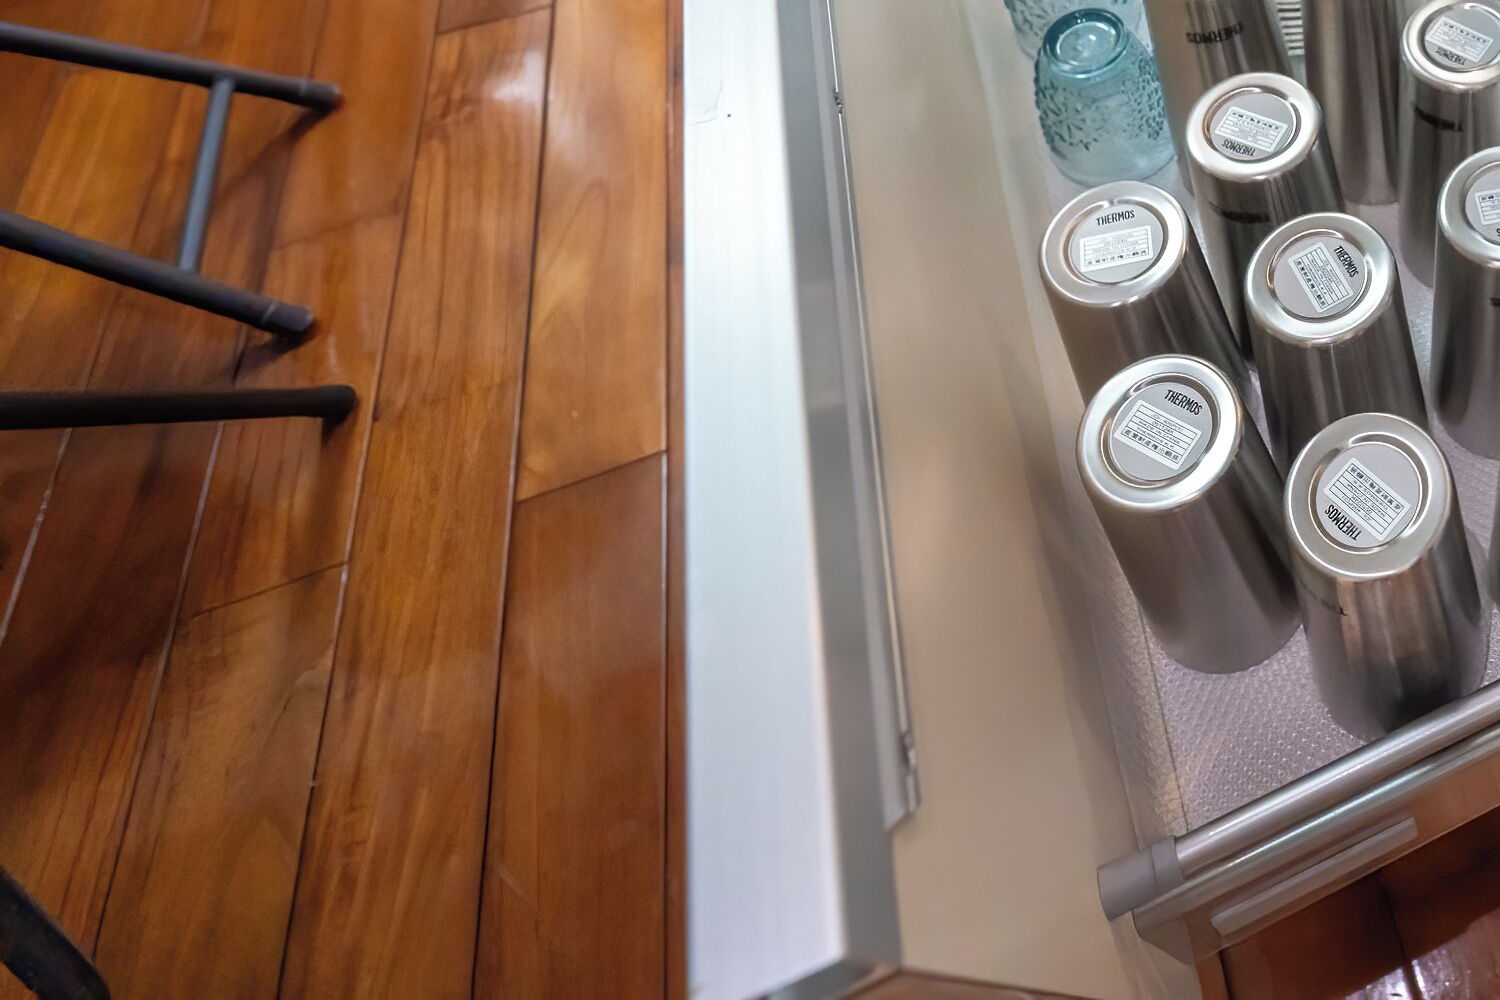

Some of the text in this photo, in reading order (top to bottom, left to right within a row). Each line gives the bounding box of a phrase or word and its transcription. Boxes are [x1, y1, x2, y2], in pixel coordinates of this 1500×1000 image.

[1222, 139, 1255, 157] THERMOS
[1096, 210, 1135, 226] THERMOS
[1334, 245, 1359, 278] THERMOS
[1164, 389, 1202, 416] THERMOS
[1325, 504, 1362, 541] THERMOS
